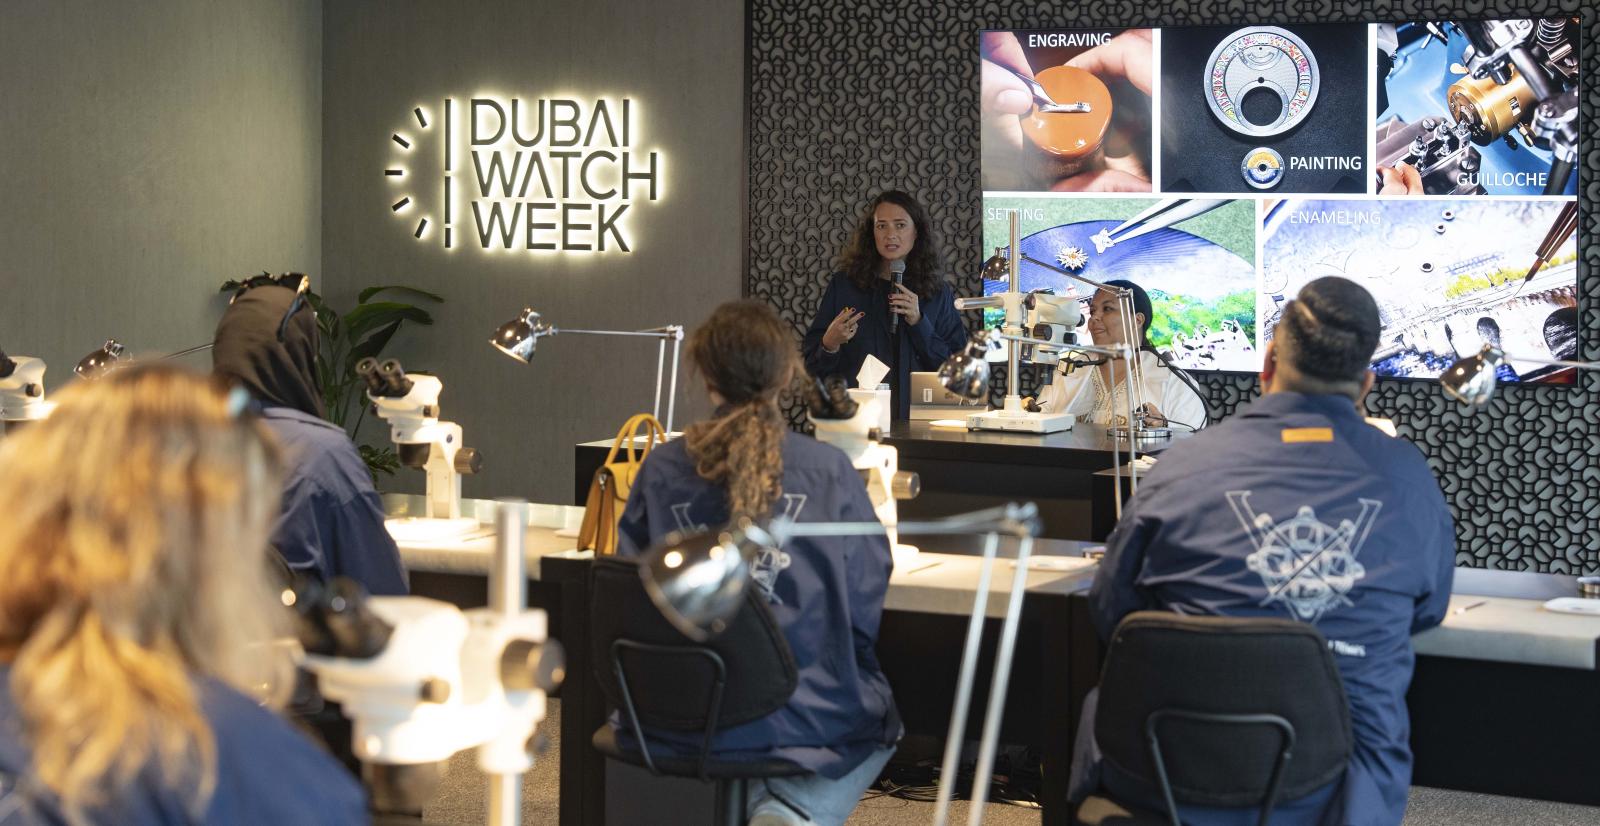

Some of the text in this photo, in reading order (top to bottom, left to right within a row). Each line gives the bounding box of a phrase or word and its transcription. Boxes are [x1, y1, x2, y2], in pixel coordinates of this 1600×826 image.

[1028, 32, 1112, 47] ENGRAVING
[471, 98, 629, 147] DUBAI
[1290, 156, 1362, 170] PAINTING
[471, 150, 656, 200] WATCH
[1456, 172, 1548, 186] GUILLOCHE
[1290, 210, 1381, 225] ENAMELING
[471, 201, 631, 252] WEEK
